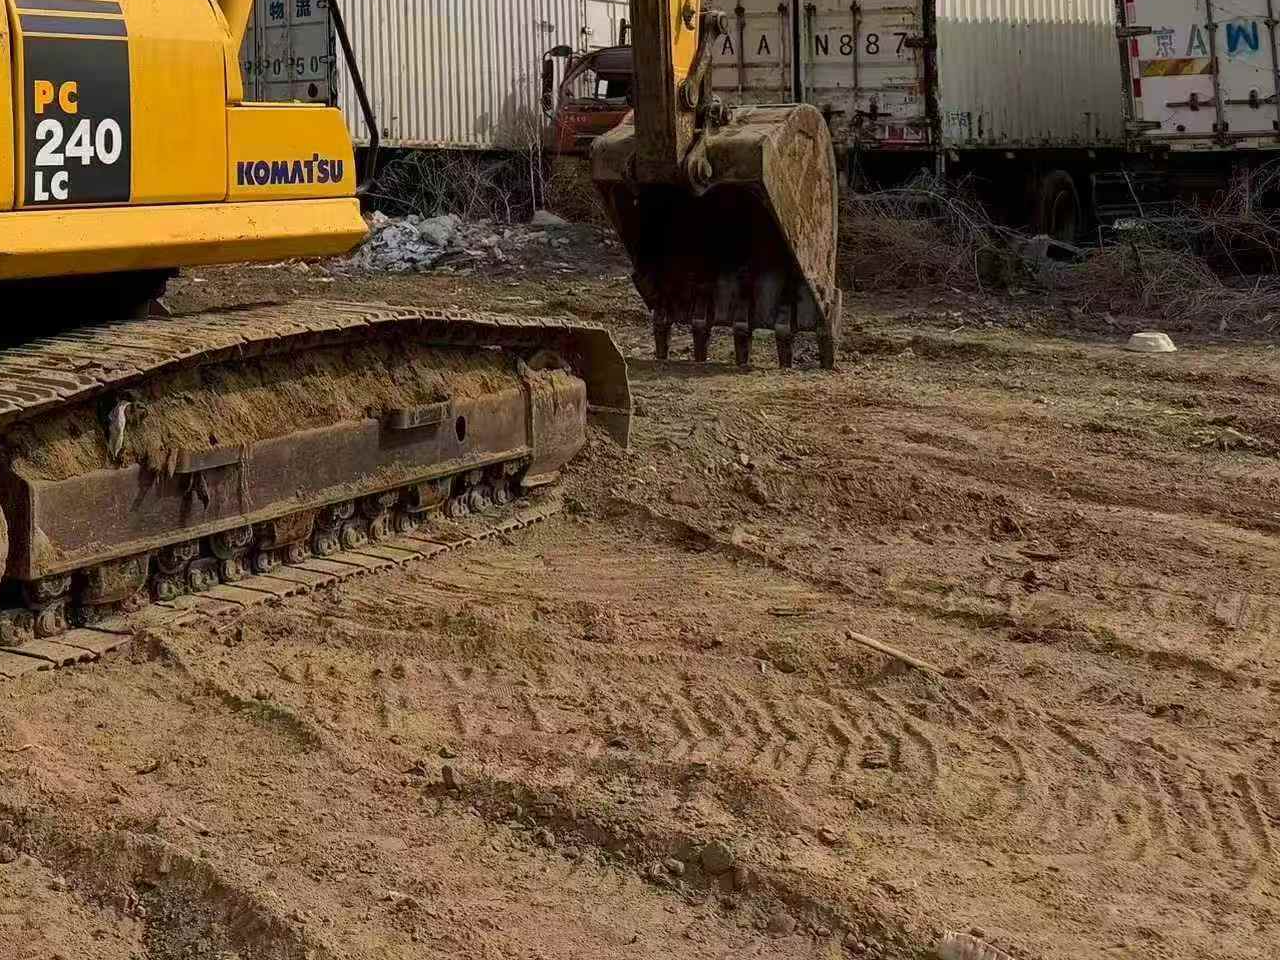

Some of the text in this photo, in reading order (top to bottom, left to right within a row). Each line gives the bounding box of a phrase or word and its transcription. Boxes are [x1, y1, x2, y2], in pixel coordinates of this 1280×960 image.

[34, 80, 79, 114] PC
[35, 119, 122, 167] 240
[34, 170, 69, 202] LC
[237, 153, 344, 187] KOMATSU
